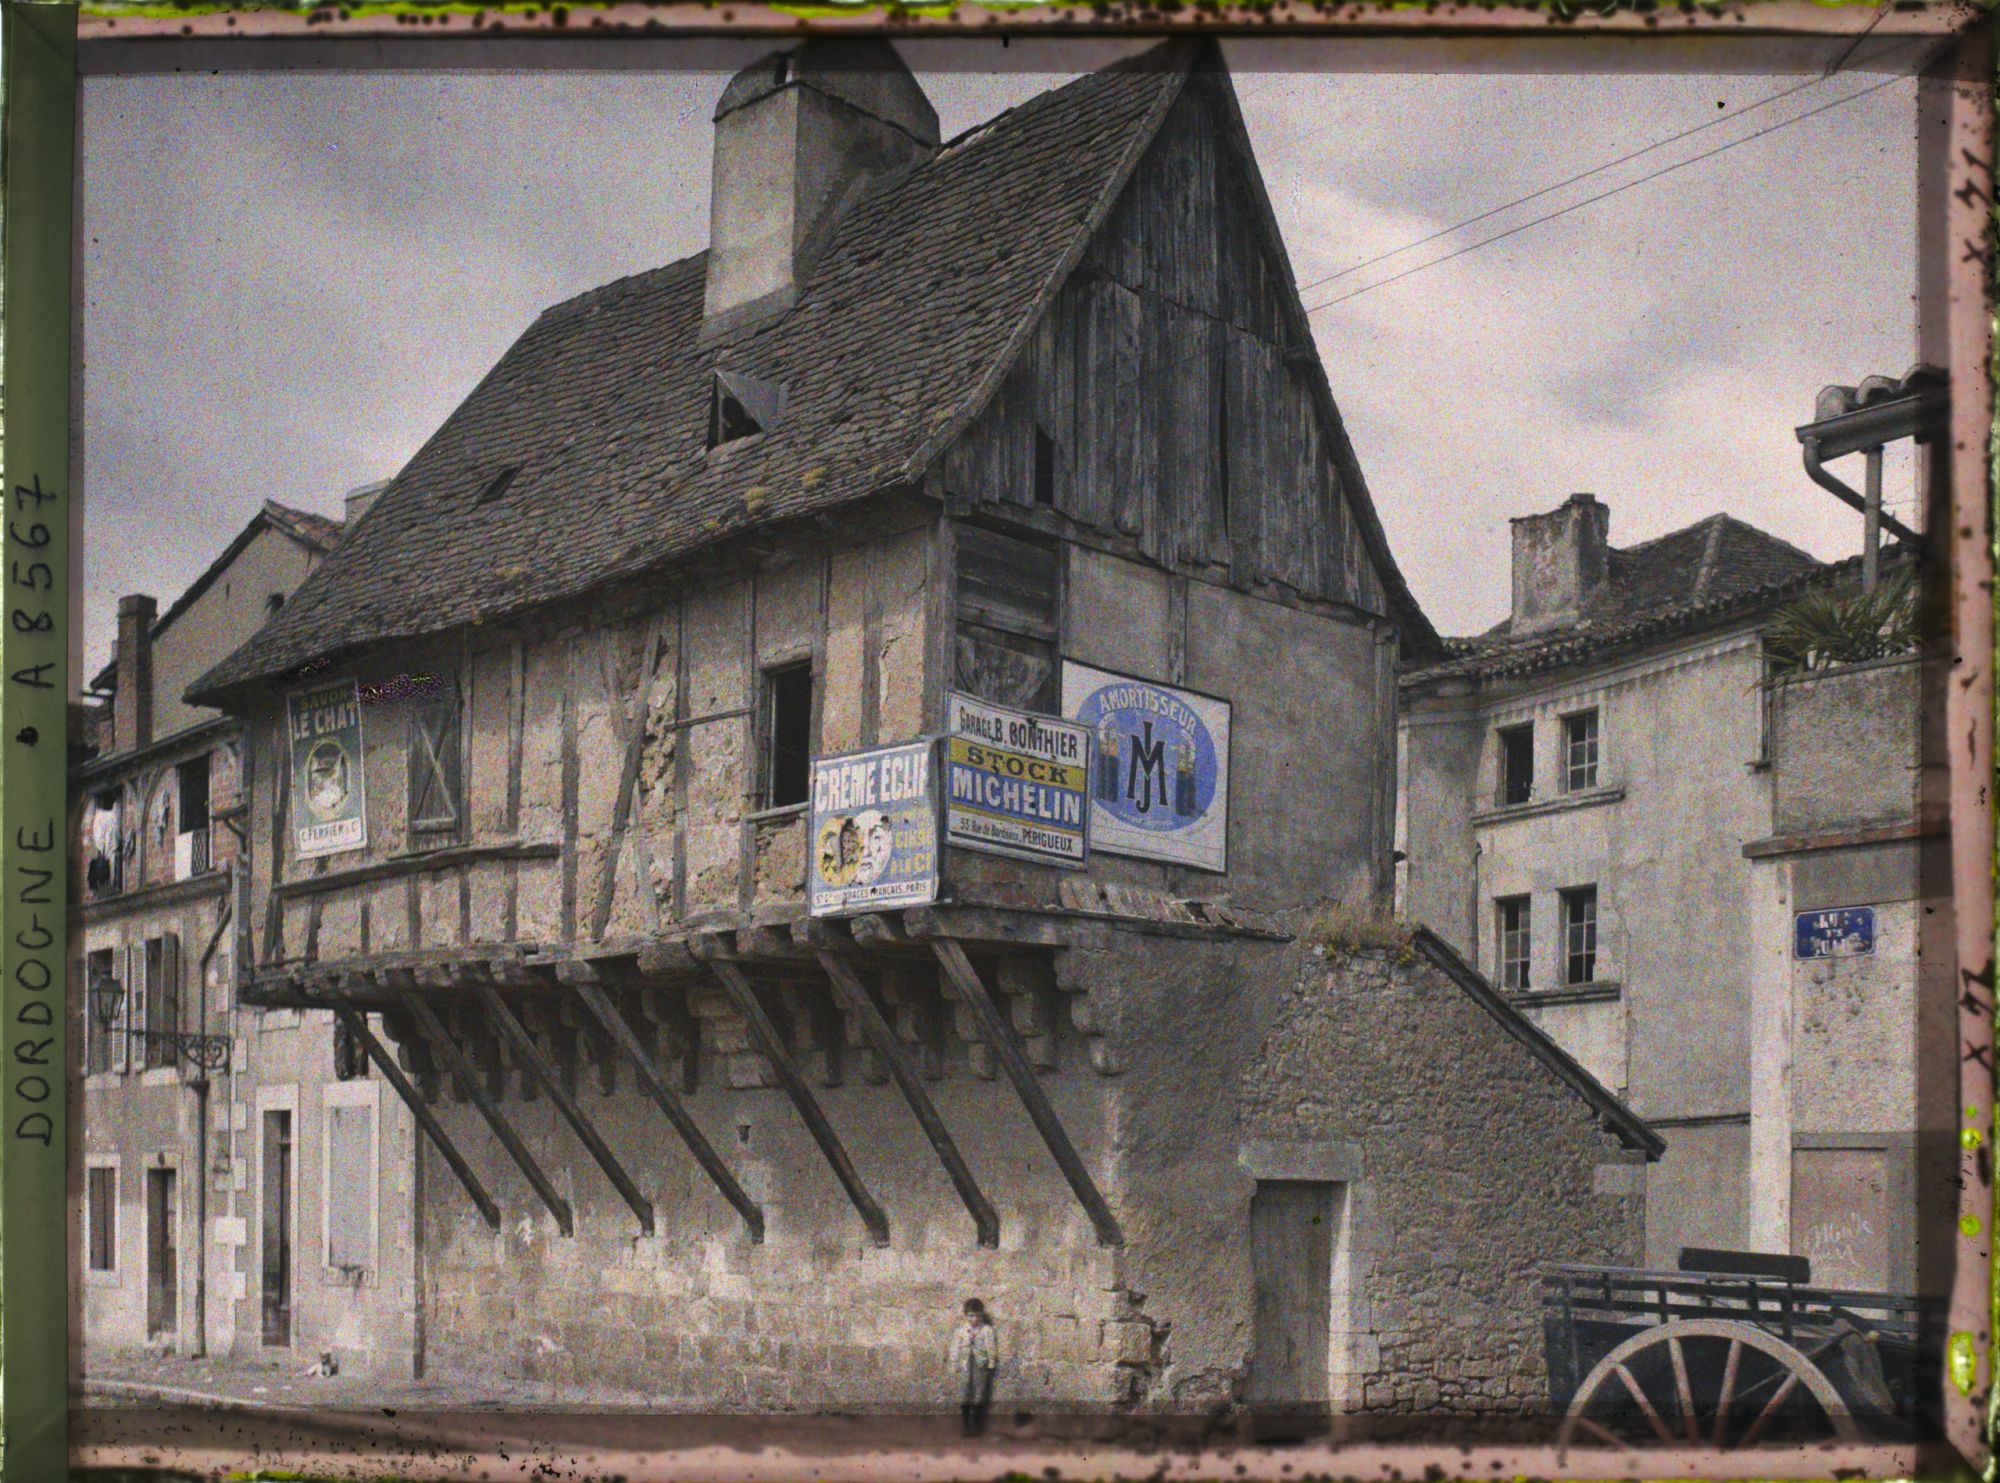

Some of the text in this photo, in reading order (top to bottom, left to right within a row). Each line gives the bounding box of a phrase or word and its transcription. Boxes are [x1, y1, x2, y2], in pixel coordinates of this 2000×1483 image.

[10, 472, 58, 634] 8567
[293, 701, 357, 741] LE CHAT
[300, 689, 349, 711] SAVON
[1099, 686, 1198, 735] AMORTISSEUR
[959, 705, 992, 740] GARAGE
[1009, 720, 1078, 760] BONTHIER
[967, 745, 1069, 785] STOCK
[953, 766, 1081, 825] MICHELIN
[15, 817, 55, 1147] DORDOGNE
